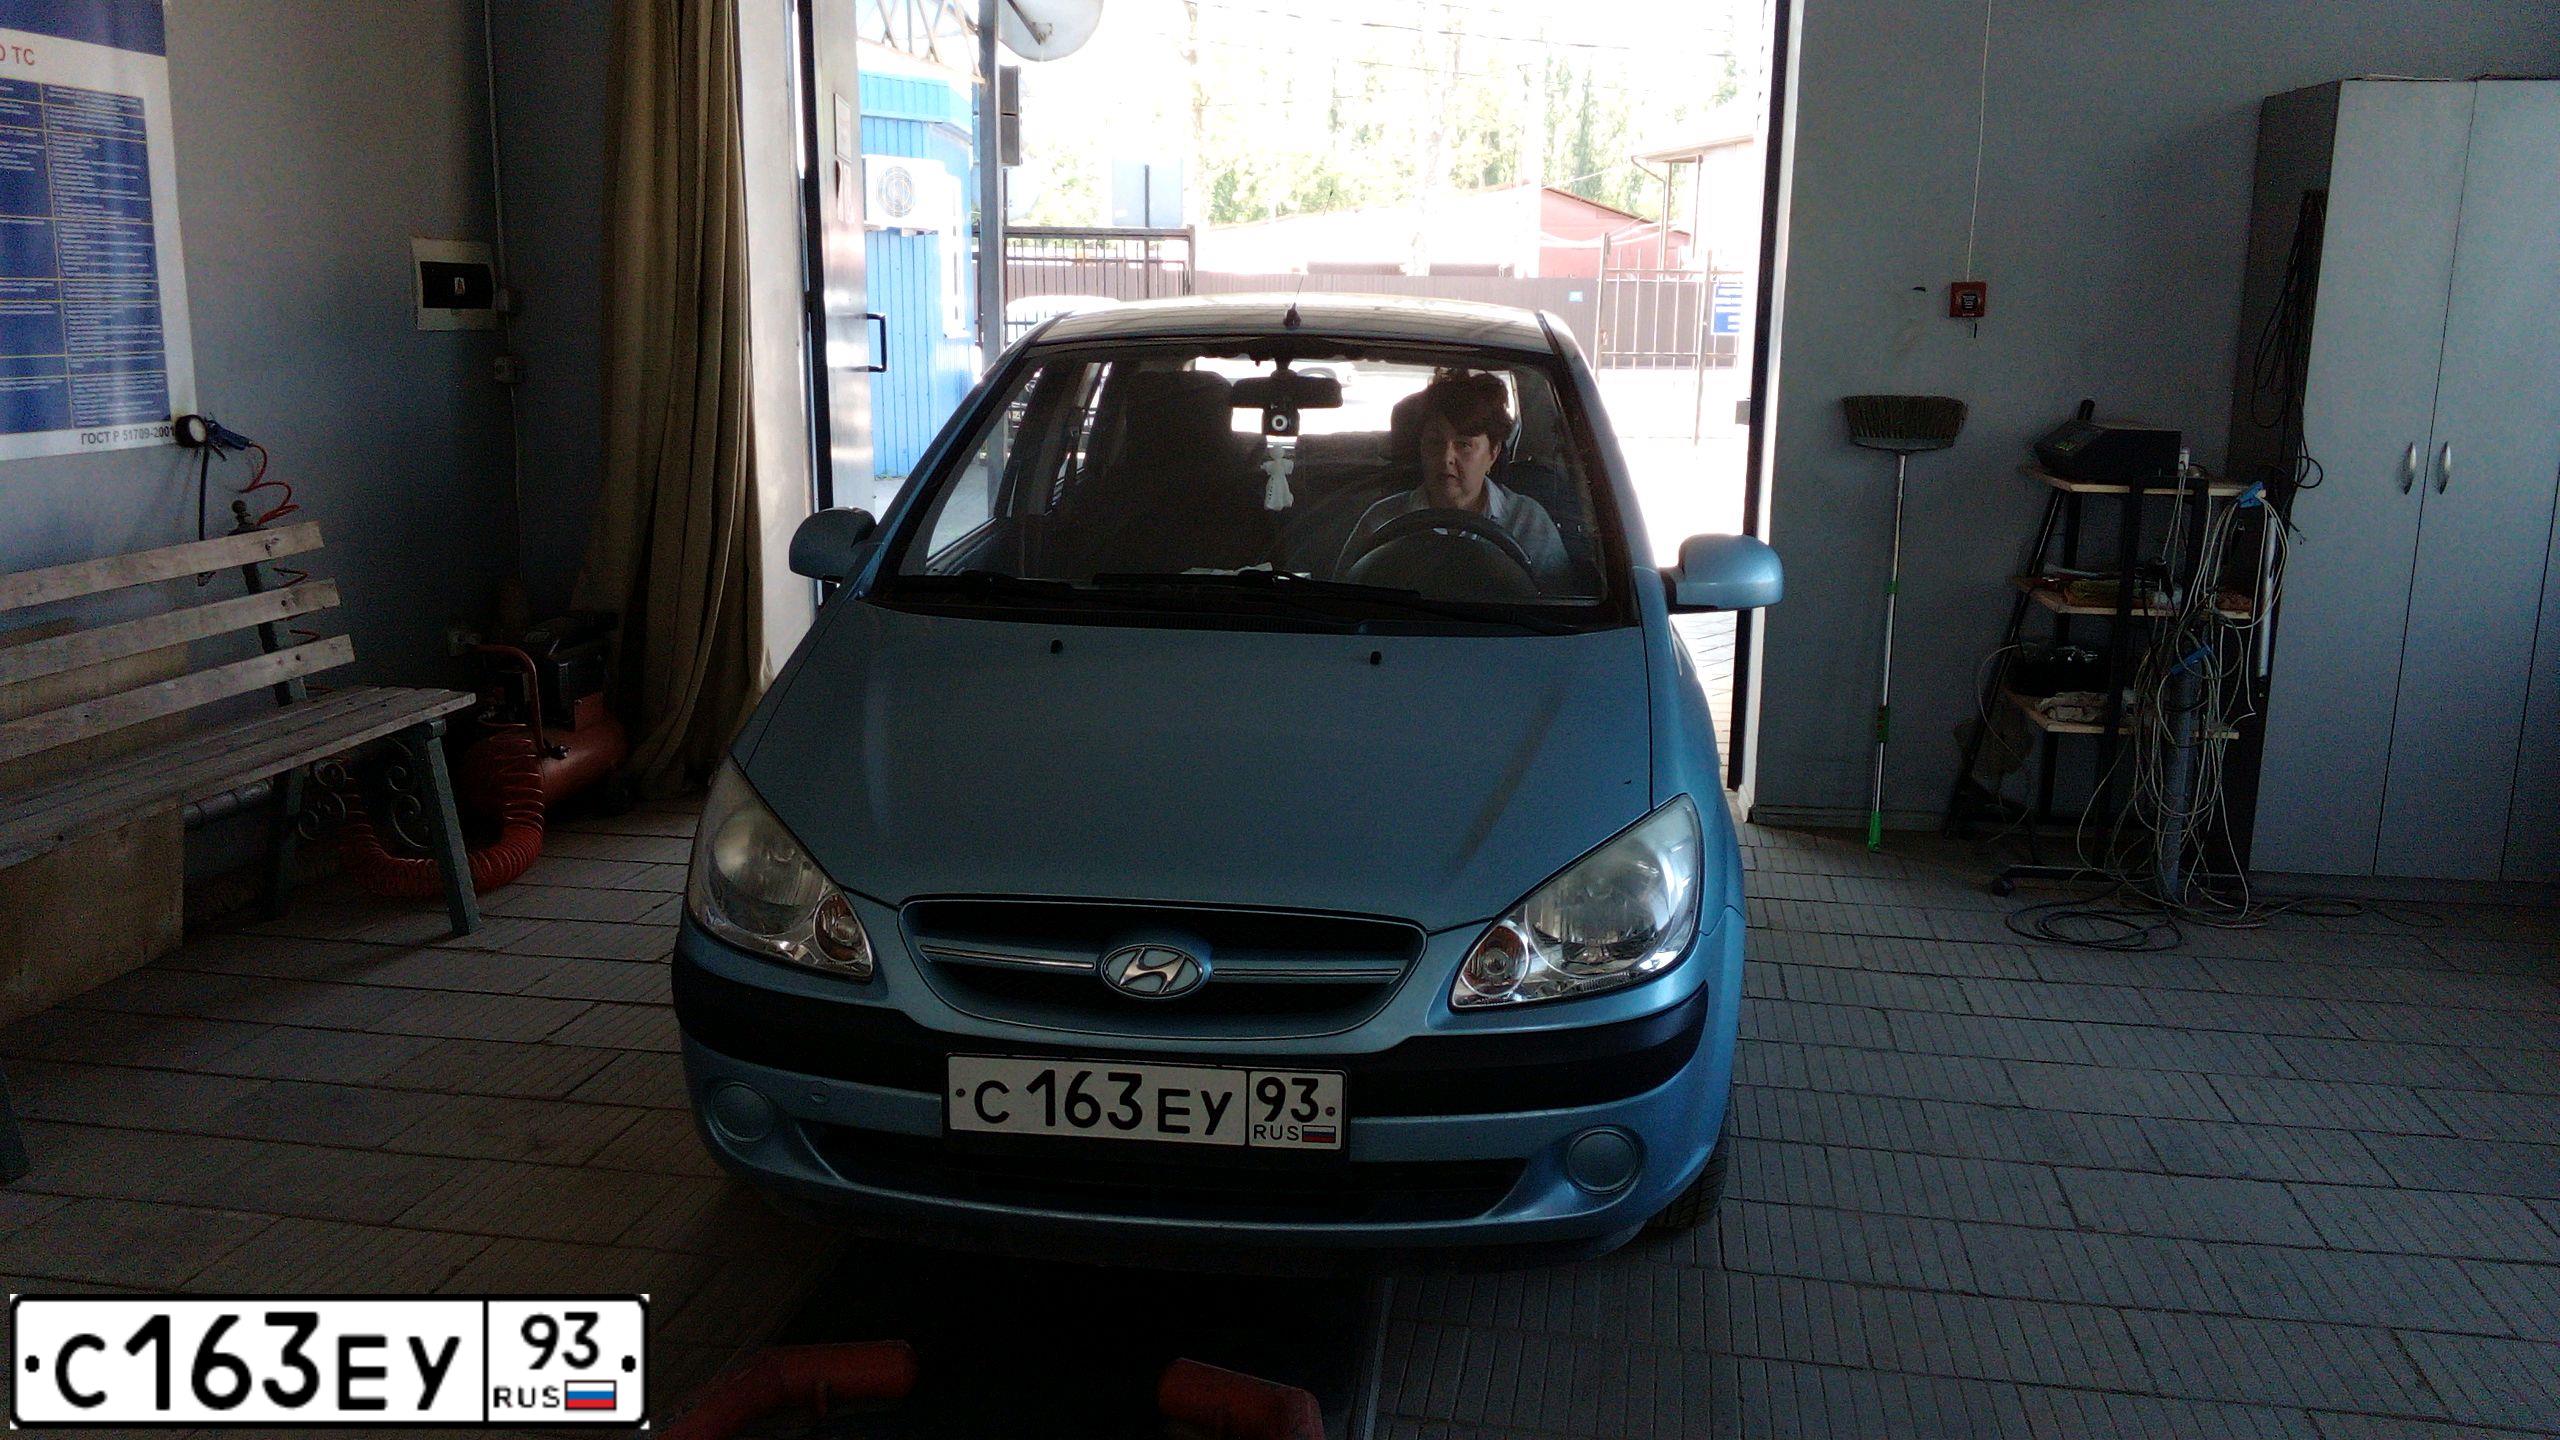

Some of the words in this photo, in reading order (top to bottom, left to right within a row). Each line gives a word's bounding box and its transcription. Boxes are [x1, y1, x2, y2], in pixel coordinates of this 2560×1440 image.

[11, 45, 35, 66] ТС
[81, 431, 111, 445] ГОСТ
[1255, 1076, 1320, 1123] 93
[1253, 1124, 1299, 1142] RUS
